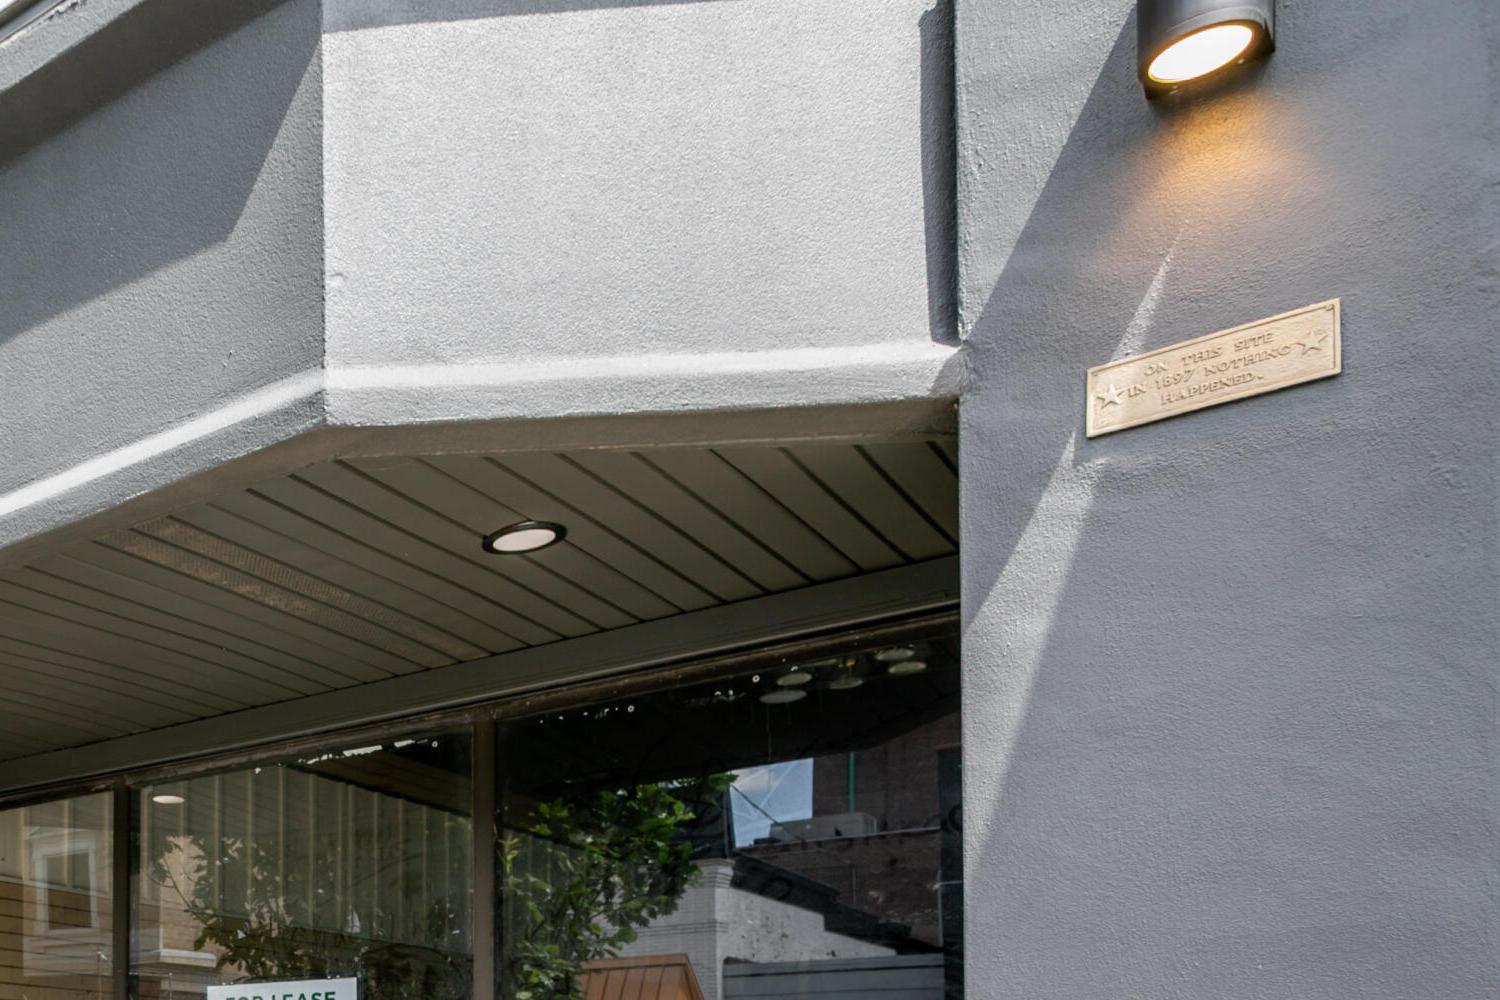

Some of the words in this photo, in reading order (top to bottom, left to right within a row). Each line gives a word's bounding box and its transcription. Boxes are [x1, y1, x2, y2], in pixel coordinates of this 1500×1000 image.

[1127, 383, 1147, 398] IN
[1155, 369, 1197, 390] 1897
[1204, 345, 1294, 377] NOTHING
[1144, 362, 1169, 377] ON
[1181, 346, 1223, 366] THIS
[1234, 332, 1274, 352] SITE
